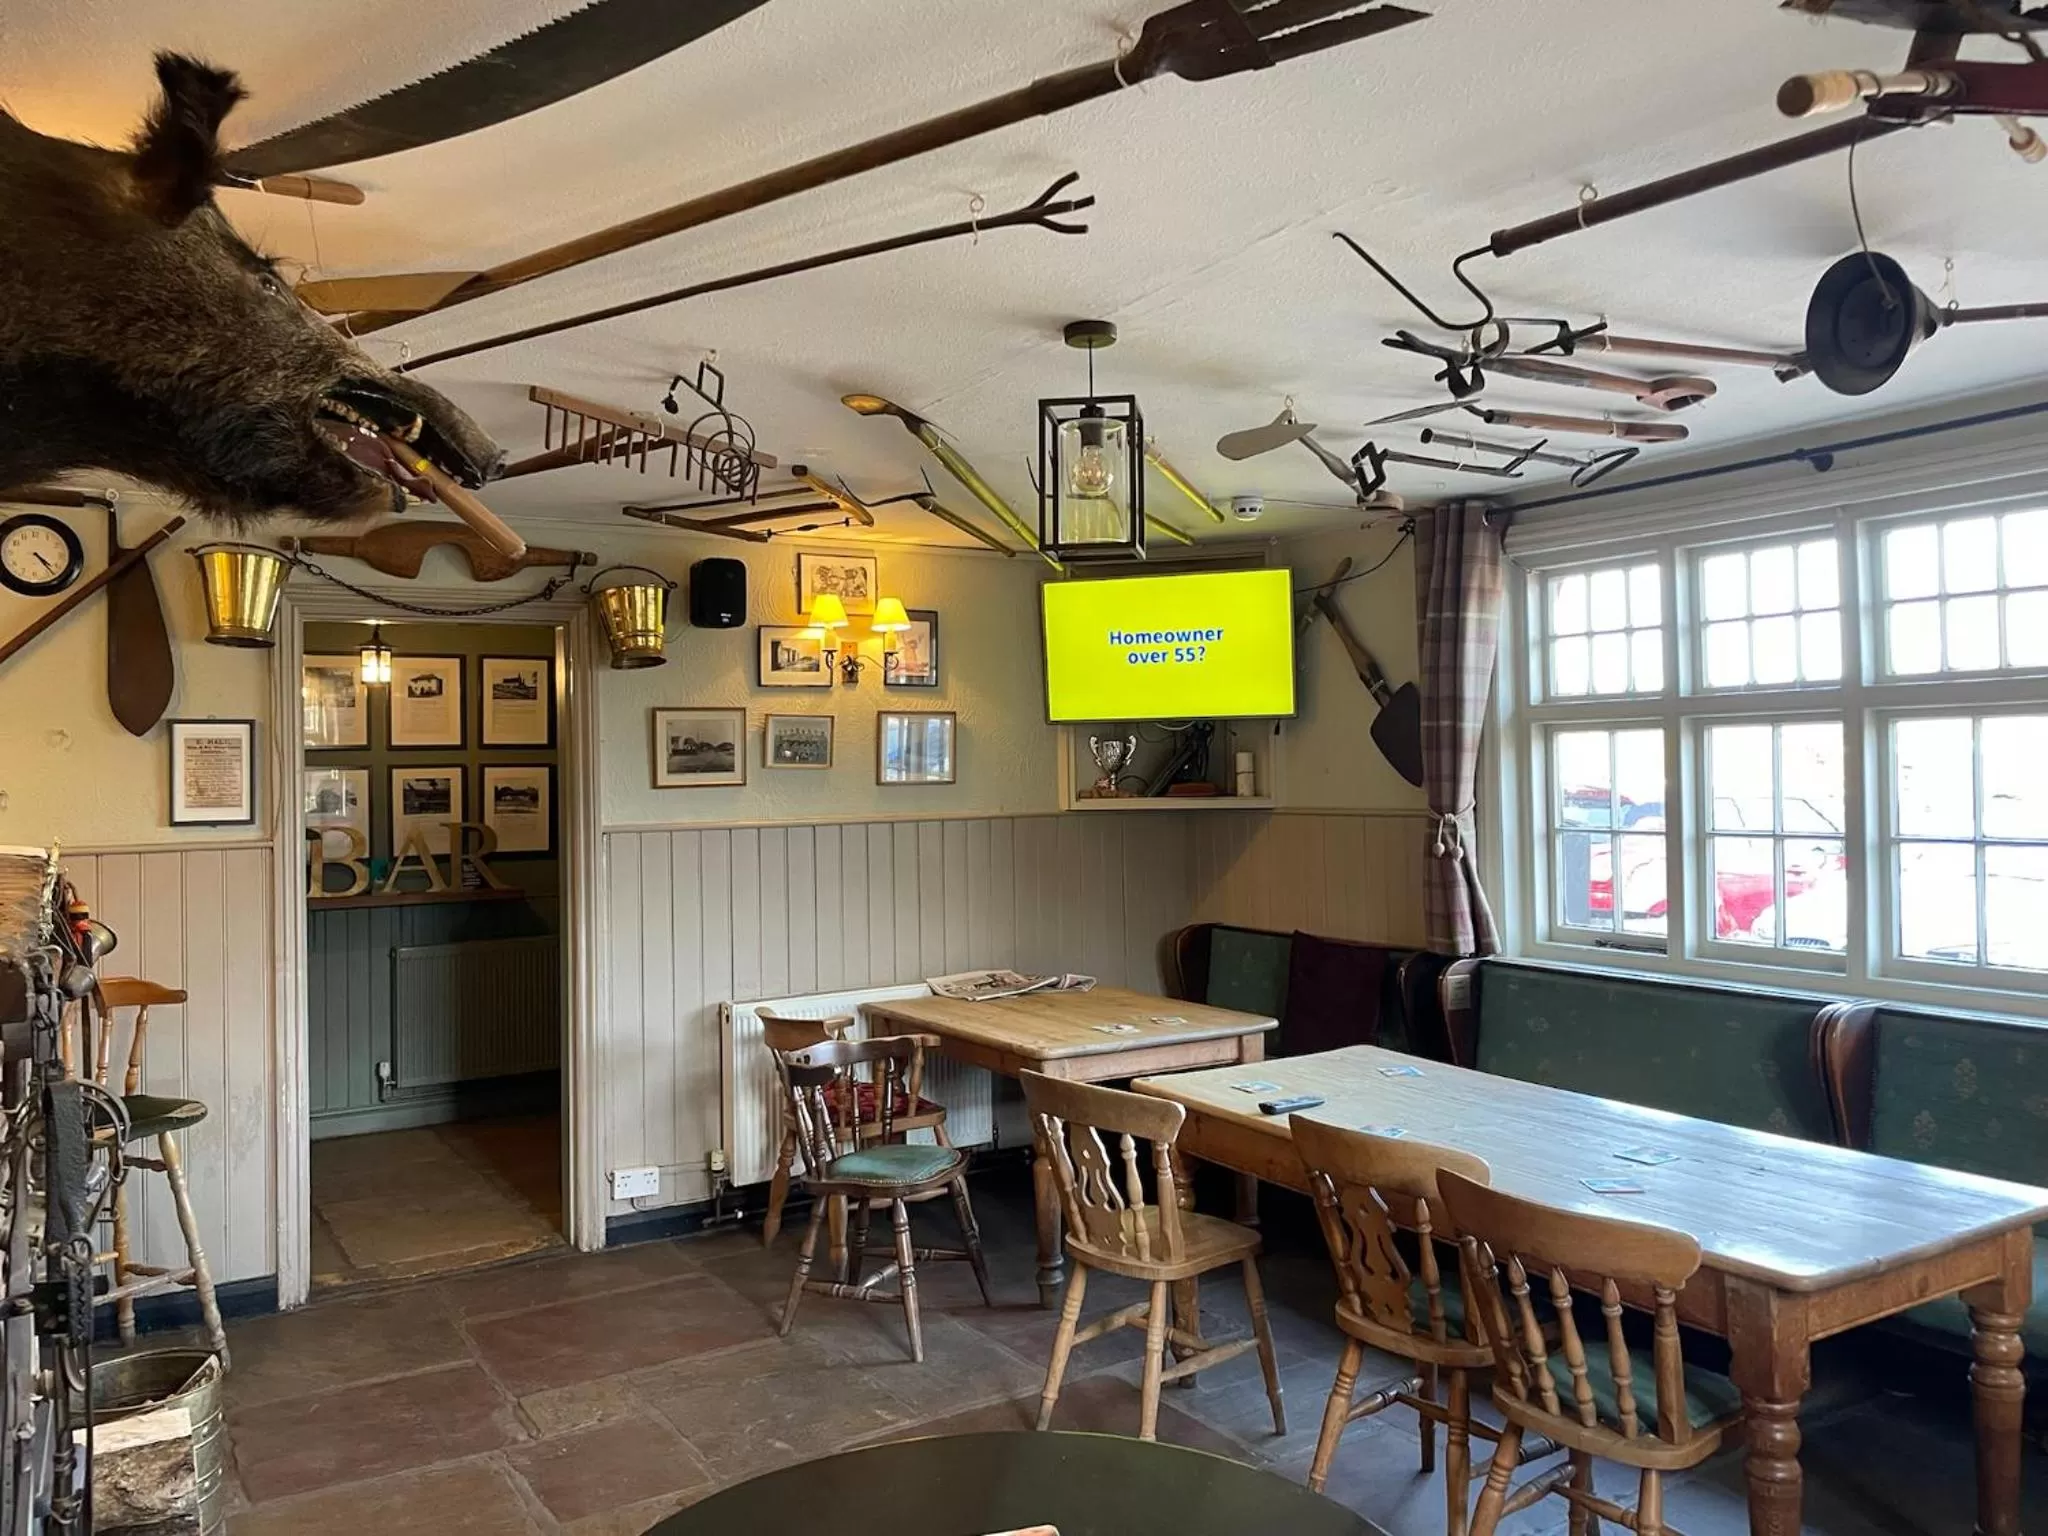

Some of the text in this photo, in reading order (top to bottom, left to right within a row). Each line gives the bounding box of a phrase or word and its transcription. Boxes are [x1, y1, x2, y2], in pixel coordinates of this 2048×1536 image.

[1109, 628, 1224, 645] Homeowner
[1128, 646, 1206, 664] over 55?
[307, 821, 516, 898] BAR
